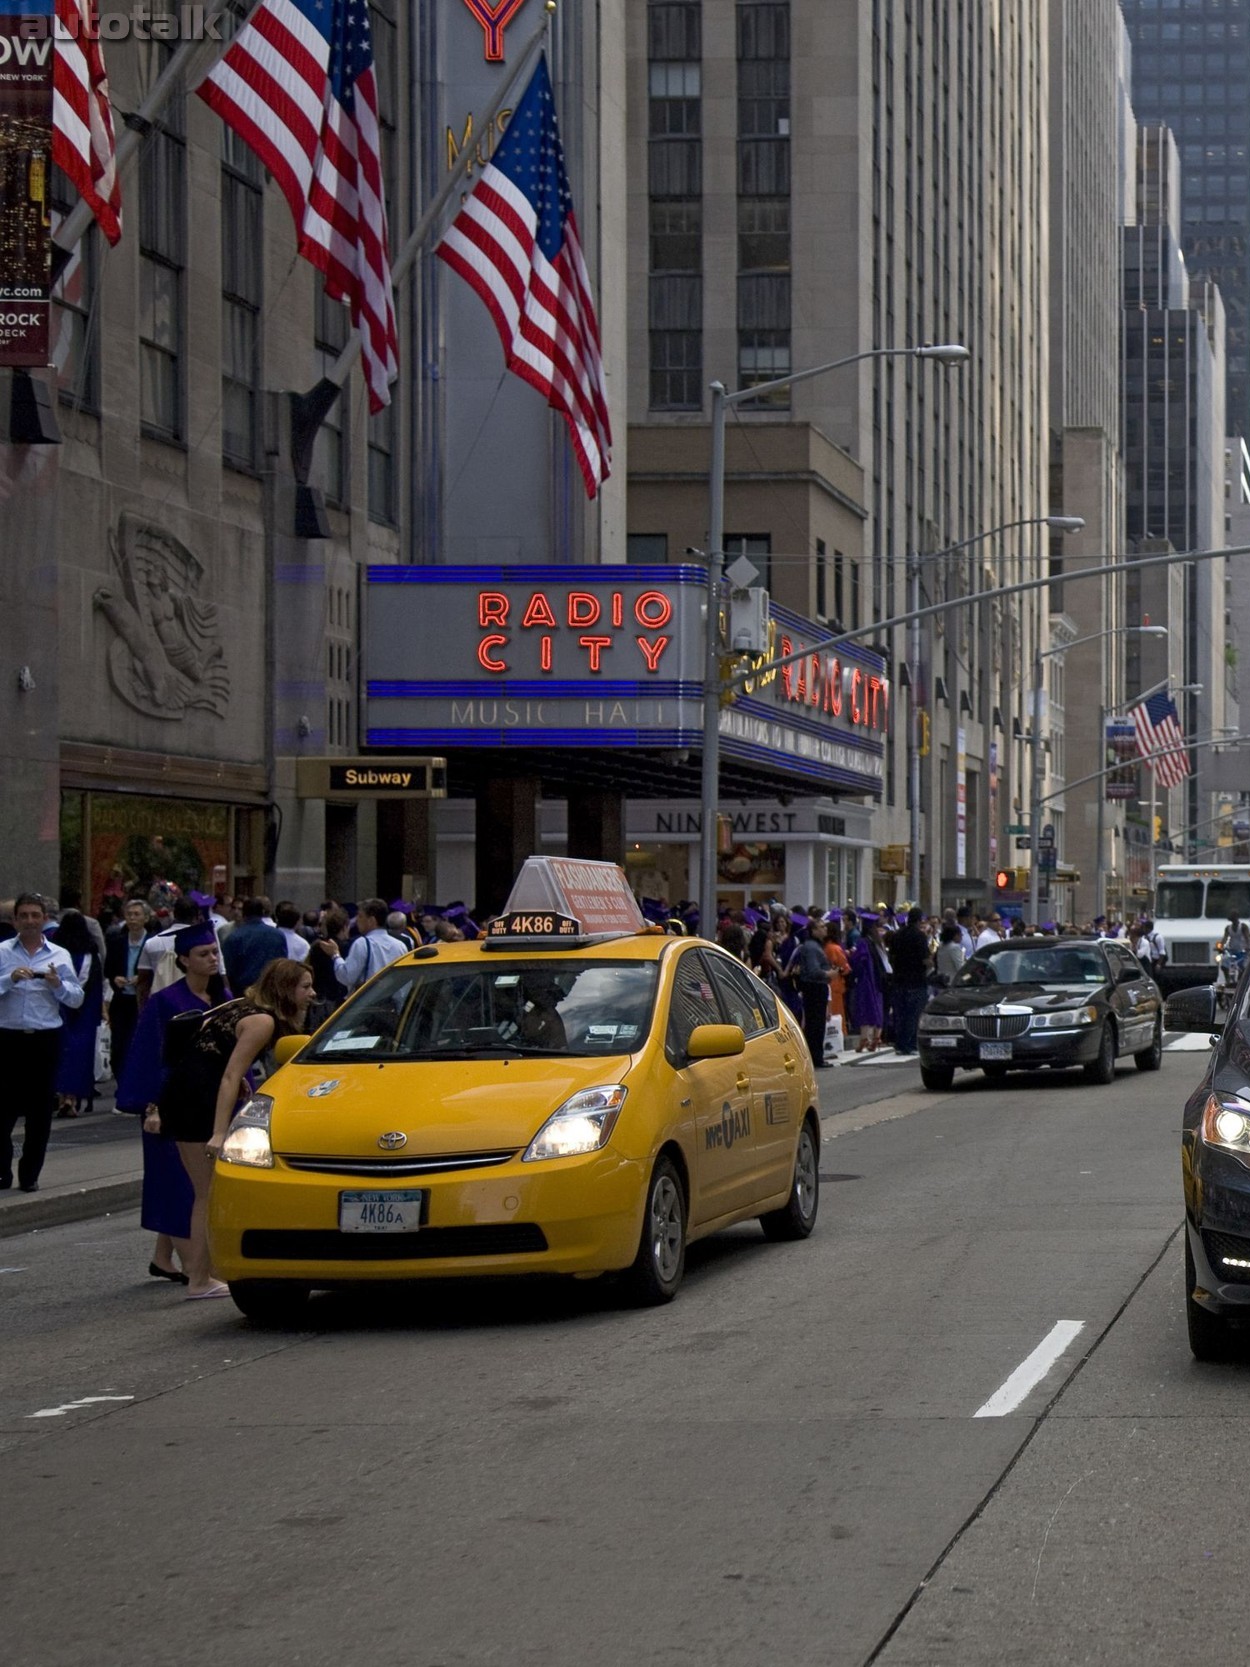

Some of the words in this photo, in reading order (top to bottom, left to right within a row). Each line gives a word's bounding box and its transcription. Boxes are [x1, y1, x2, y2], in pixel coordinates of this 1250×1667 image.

[21, 74, 44, 82] YORK
[478, 591, 672, 629] RADIO
[477, 634, 668, 671] CITY
[852, 667, 889, 733] CITY
[451, 700, 555, 725] MUSIC
[585, 700, 672, 725] HALL
[345, 769, 412, 787] Subway
[656, 812, 702, 833] NIN
[731, 812, 797, 833] WEST
[511, 916, 553, 933] 4K86
[360, 1203, 404, 1224] 4K86A
